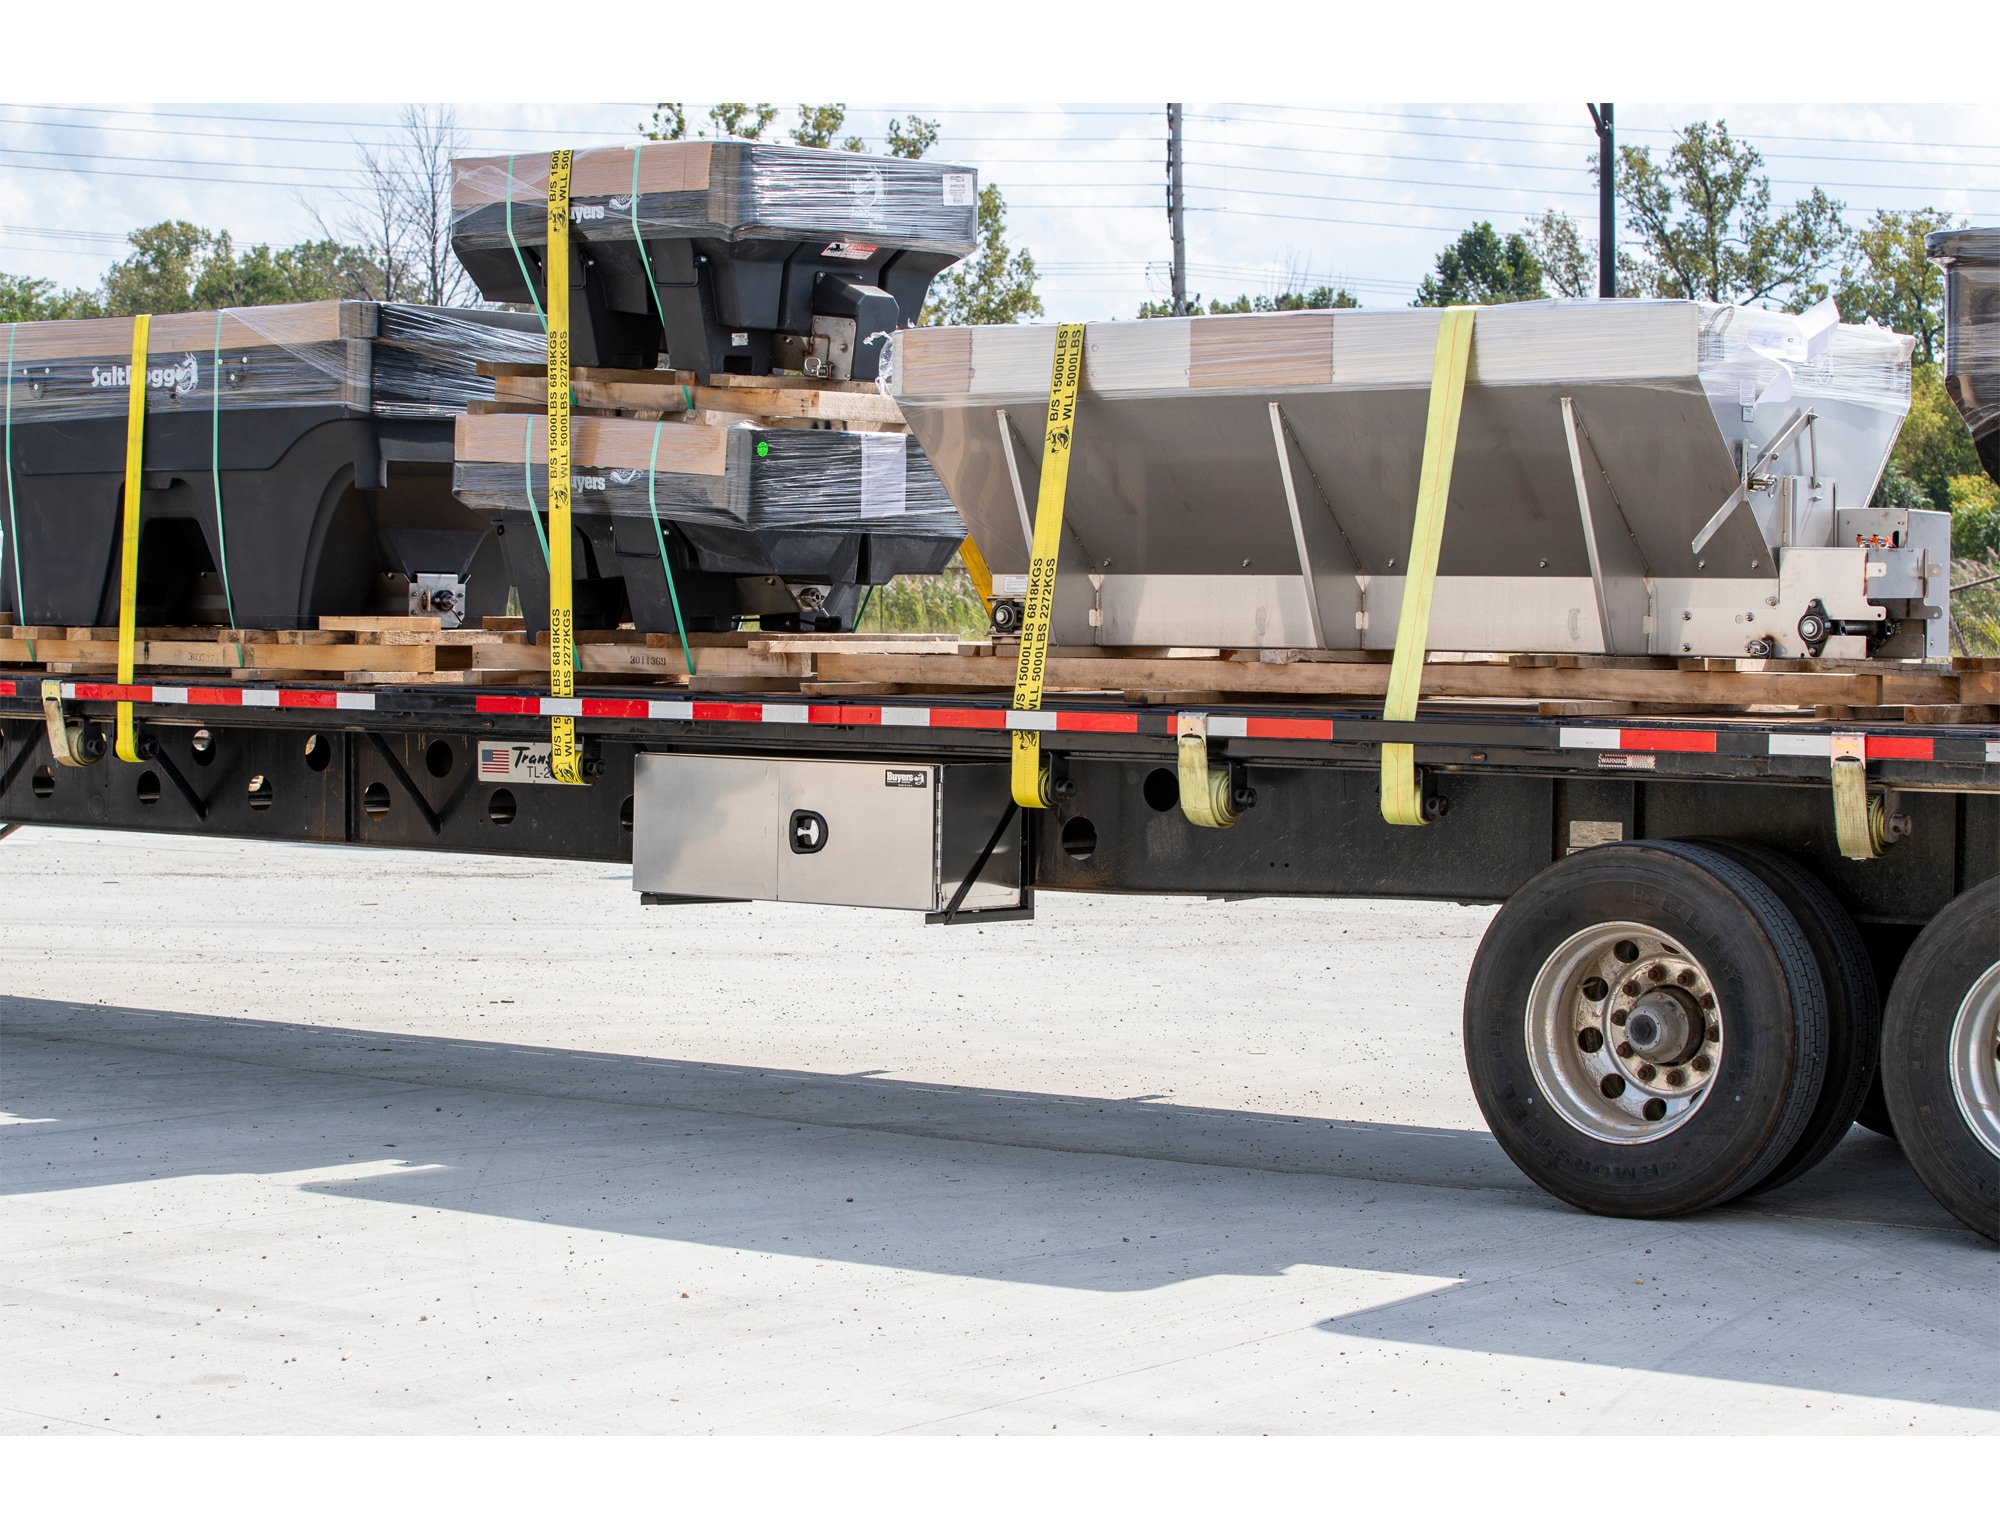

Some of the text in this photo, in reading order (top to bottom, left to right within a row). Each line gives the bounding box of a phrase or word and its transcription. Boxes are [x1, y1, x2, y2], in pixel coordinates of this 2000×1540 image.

[549, 181, 557, 202] B/S
[559, 173, 568, 202] WLL
[569, 205, 605, 224] uyers
[91, 364, 175, 388] Saltgg
[1050, 330, 1068, 421] B/S 15000LBS
[1062, 329, 1081, 421] WLL 5000LBS
[550, 330, 558, 479] B/S 15000LBS 6818KGS
[560, 331, 568, 479] WLL 5000LBS 2272KGS
[570, 475, 606, 494] uyers
[1018, 623, 1035, 688] 15000LBS
[1027, 558, 1043, 618] 6818KGS
[1031, 623, 1047, 681] 5000LBS
[1040, 558, 1056, 619] 2272KGS
[552, 608, 561, 666] 6818KGS
[563, 609, 571, 666] 2272KGS
[630, 655, 666, 667] 3011369
[554, 735, 562, 757] B/S
[565, 728, 573, 757] WLL
[526, 765, 552, 779] TL-2
[886, 771, 914, 784] Buyers
